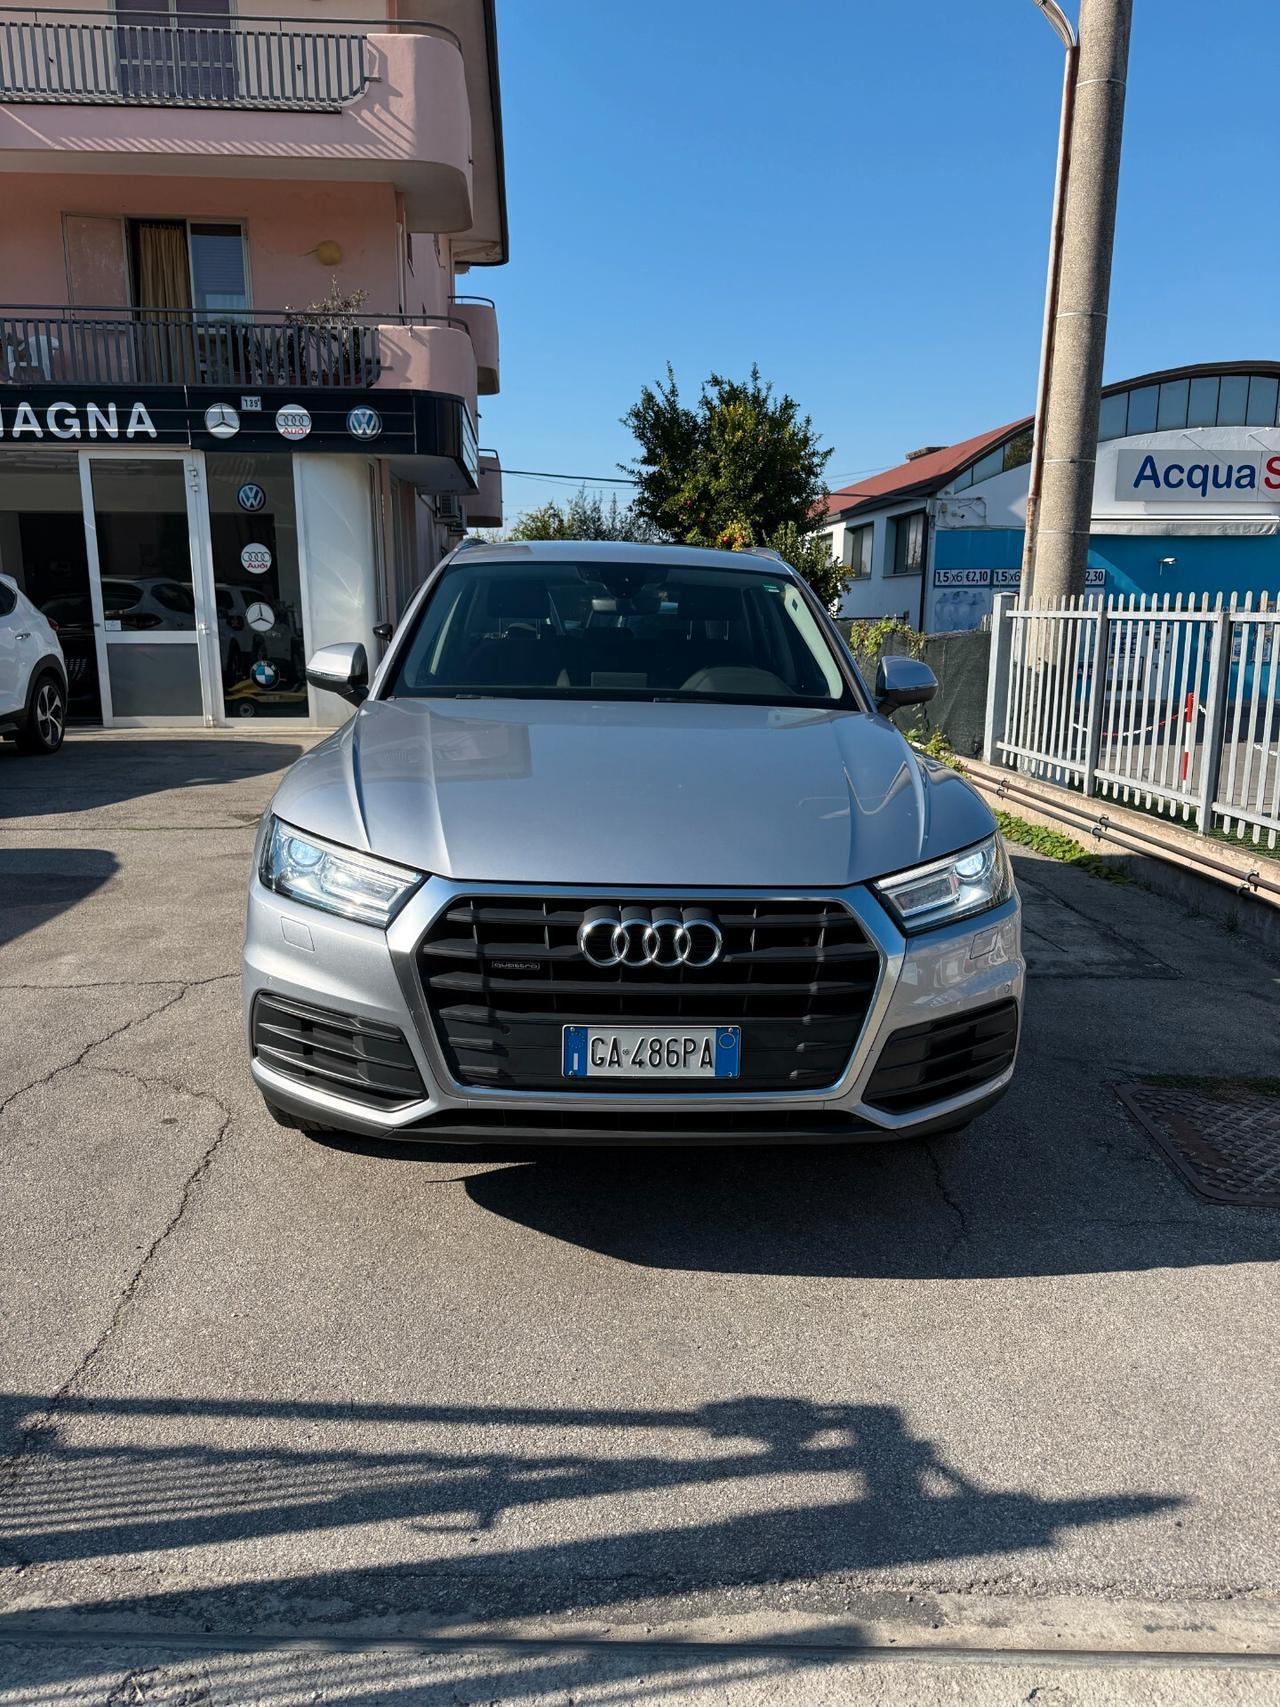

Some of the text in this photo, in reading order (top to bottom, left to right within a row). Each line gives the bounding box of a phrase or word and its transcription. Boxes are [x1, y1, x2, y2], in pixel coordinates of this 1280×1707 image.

[0, 401, 158, 439] AGNA
[282, 427, 308, 435] Audi
[1133, 455, 1256, 498] Acqua
[247, 562, 269, 570] Audi
[966, 571, 988, 583] €2,10
